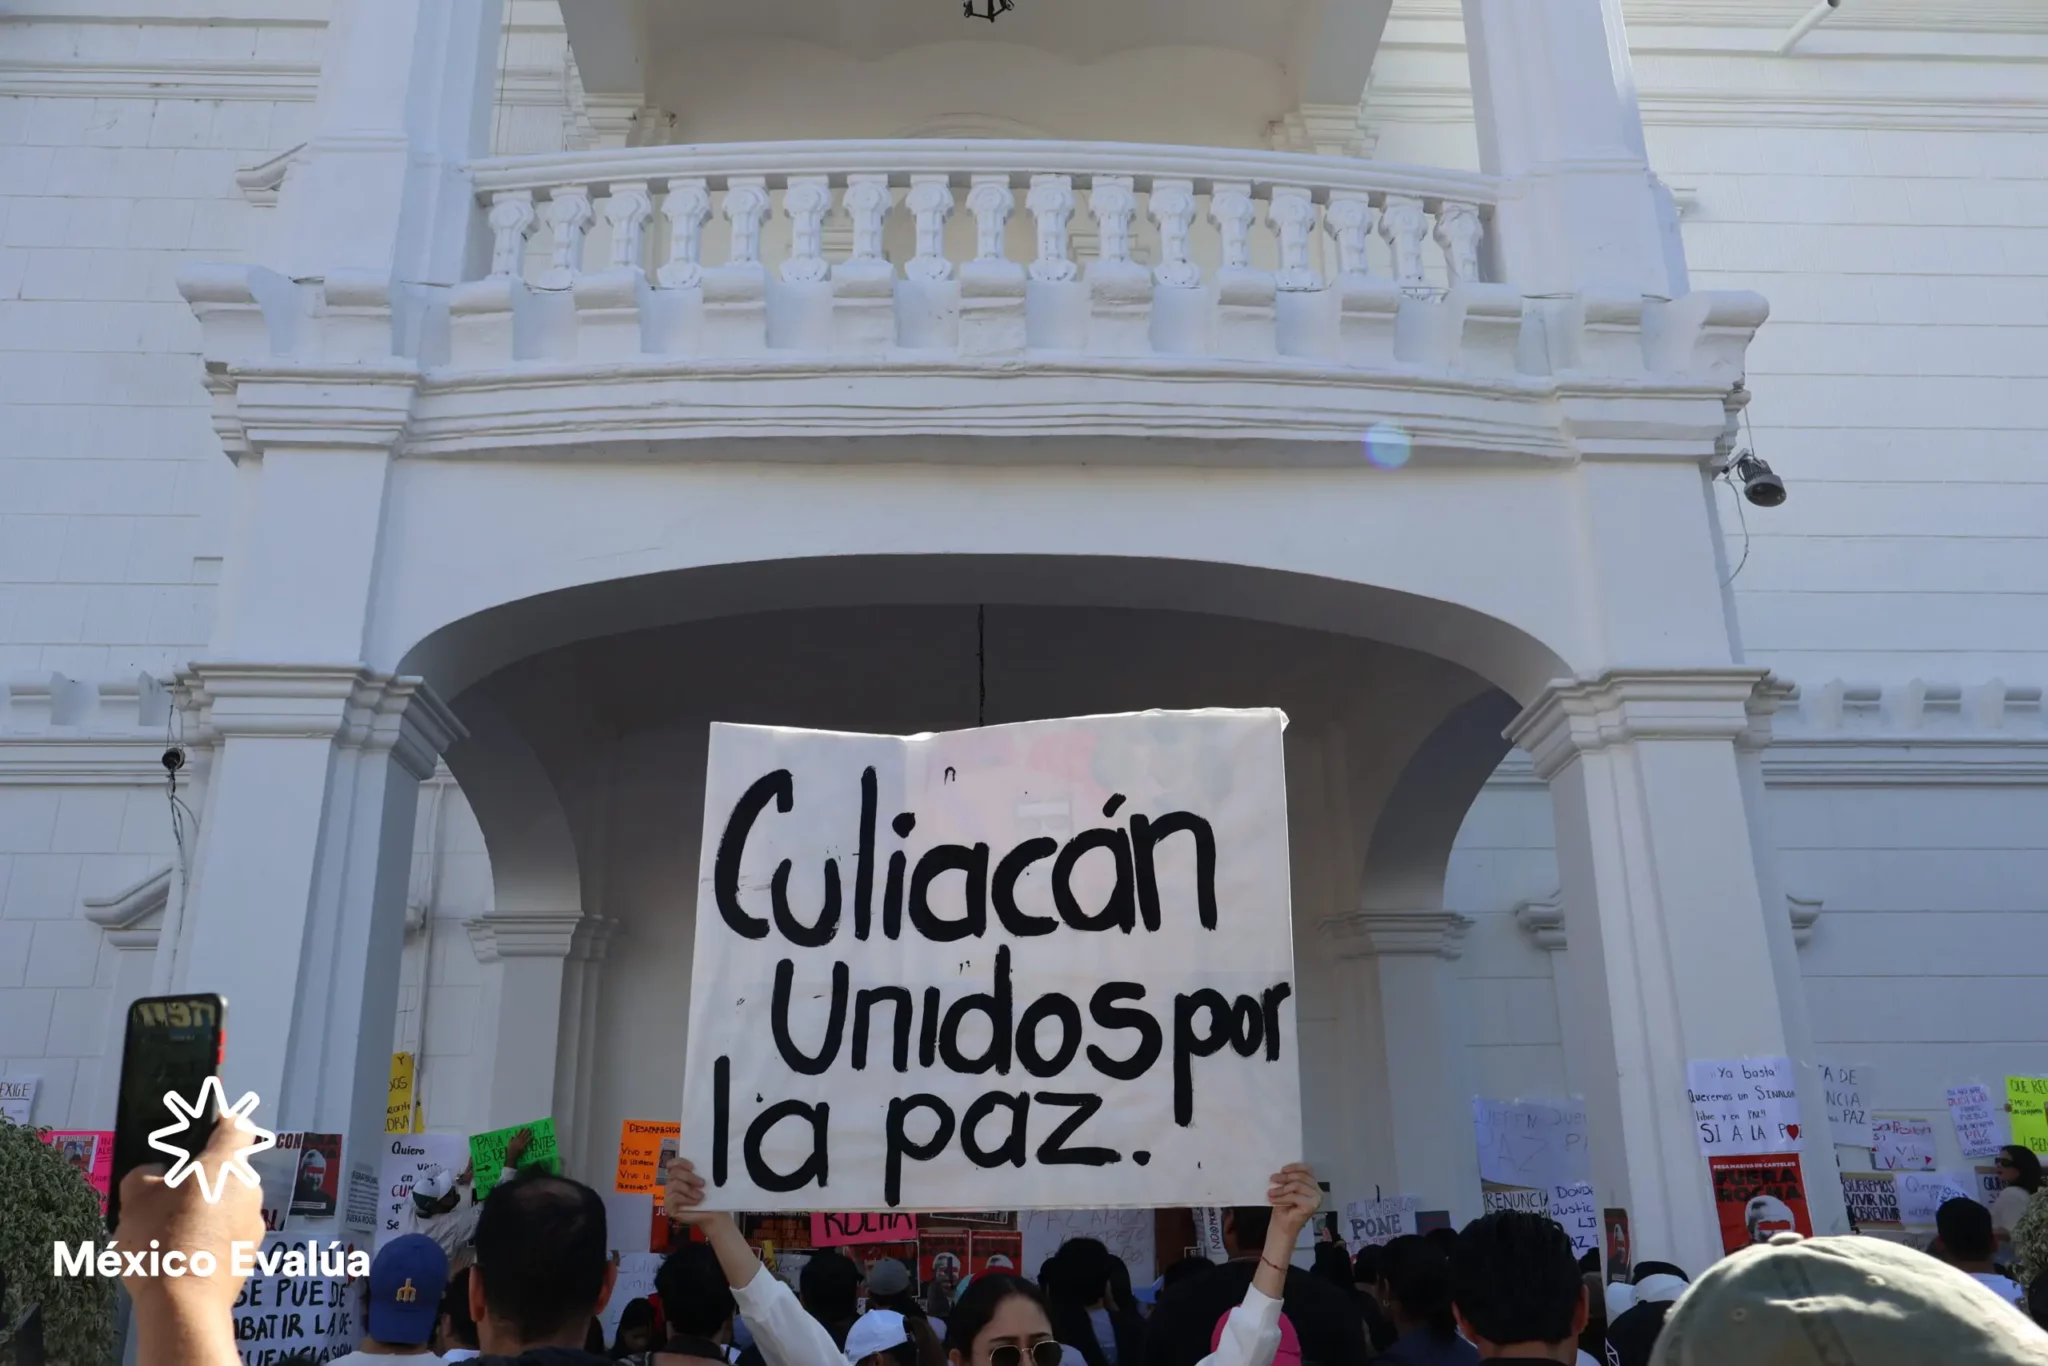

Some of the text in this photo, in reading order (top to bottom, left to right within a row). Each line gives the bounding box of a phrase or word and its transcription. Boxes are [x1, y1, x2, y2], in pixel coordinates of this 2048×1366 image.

[714, 765, 1217, 947] Culiacán
[771, 944, 1291, 1127] Unidos por
[1688, 1089, 1733, 1103] Queremos
[1696, 1110, 1715, 1121] libre
[1843, 1109, 1866, 1124] PAZ
[712, 1055, 1152, 1206] la paz.
[1732, 1125, 1743, 1141] A
[1751, 1125, 1766, 1141] LA
[392, 1141, 425, 1155] Quiero
[1715, 1168, 1798, 1185] FUERA
[1843, 1180, 1895, 1193] QUEREMOS
[1845, 1193, 1897, 1206] VIVIR NO
[1349, 1214, 1402, 1240] PONE
[276, 1279, 346, 1307] PUEDE
